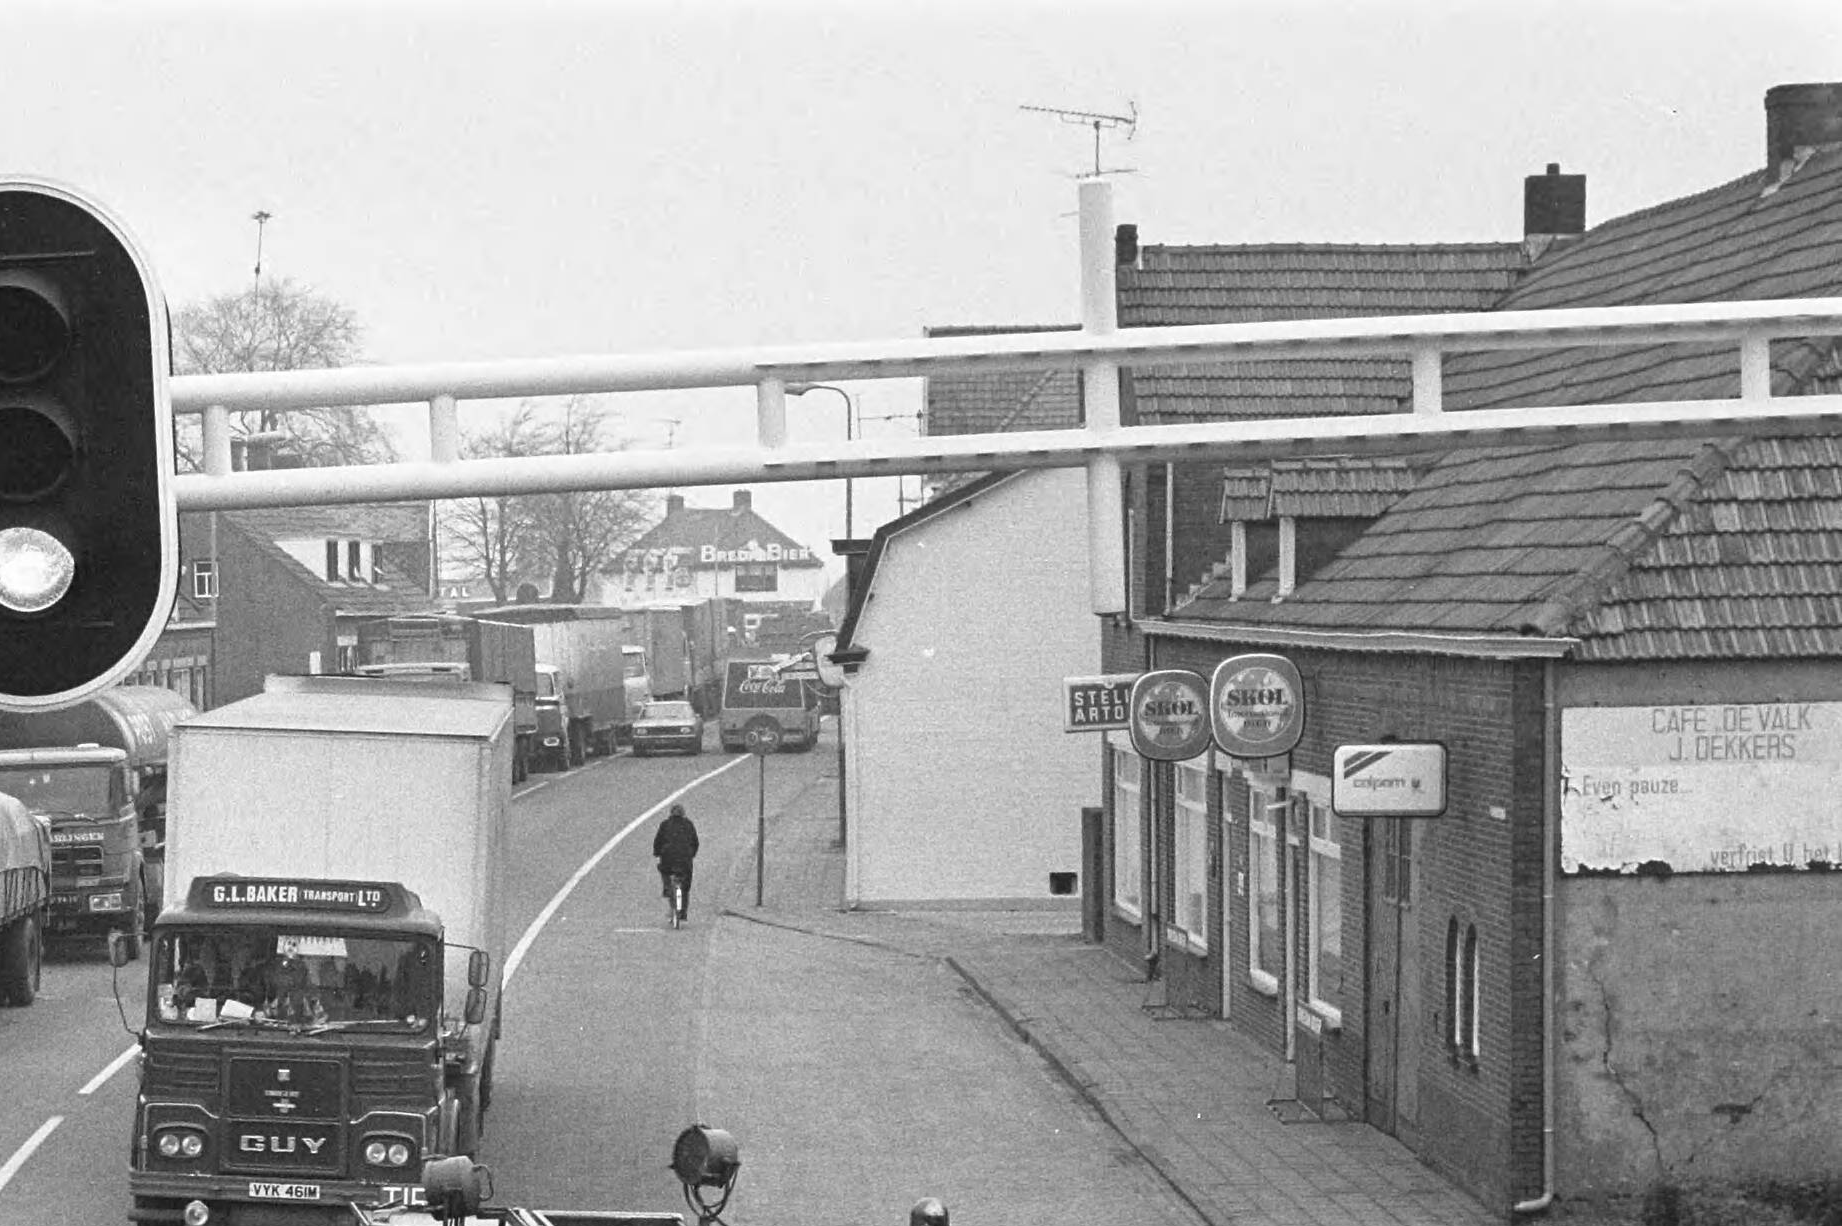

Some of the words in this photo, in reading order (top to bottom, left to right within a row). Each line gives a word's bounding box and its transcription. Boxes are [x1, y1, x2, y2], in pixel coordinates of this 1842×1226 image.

[1652, 707, 1708, 733] CAFE
[1759, 705, 1812, 732] VALK
[1669, 737, 1688, 761] J.
[1695, 734, 1796, 761] DEKKERS
[1582, 775, 1622, 797] Even
[239, 1135, 327, 1154] GUY
[252, 1183, 281, 1197] VYK
[285, 1184, 318, 1198] 461M
